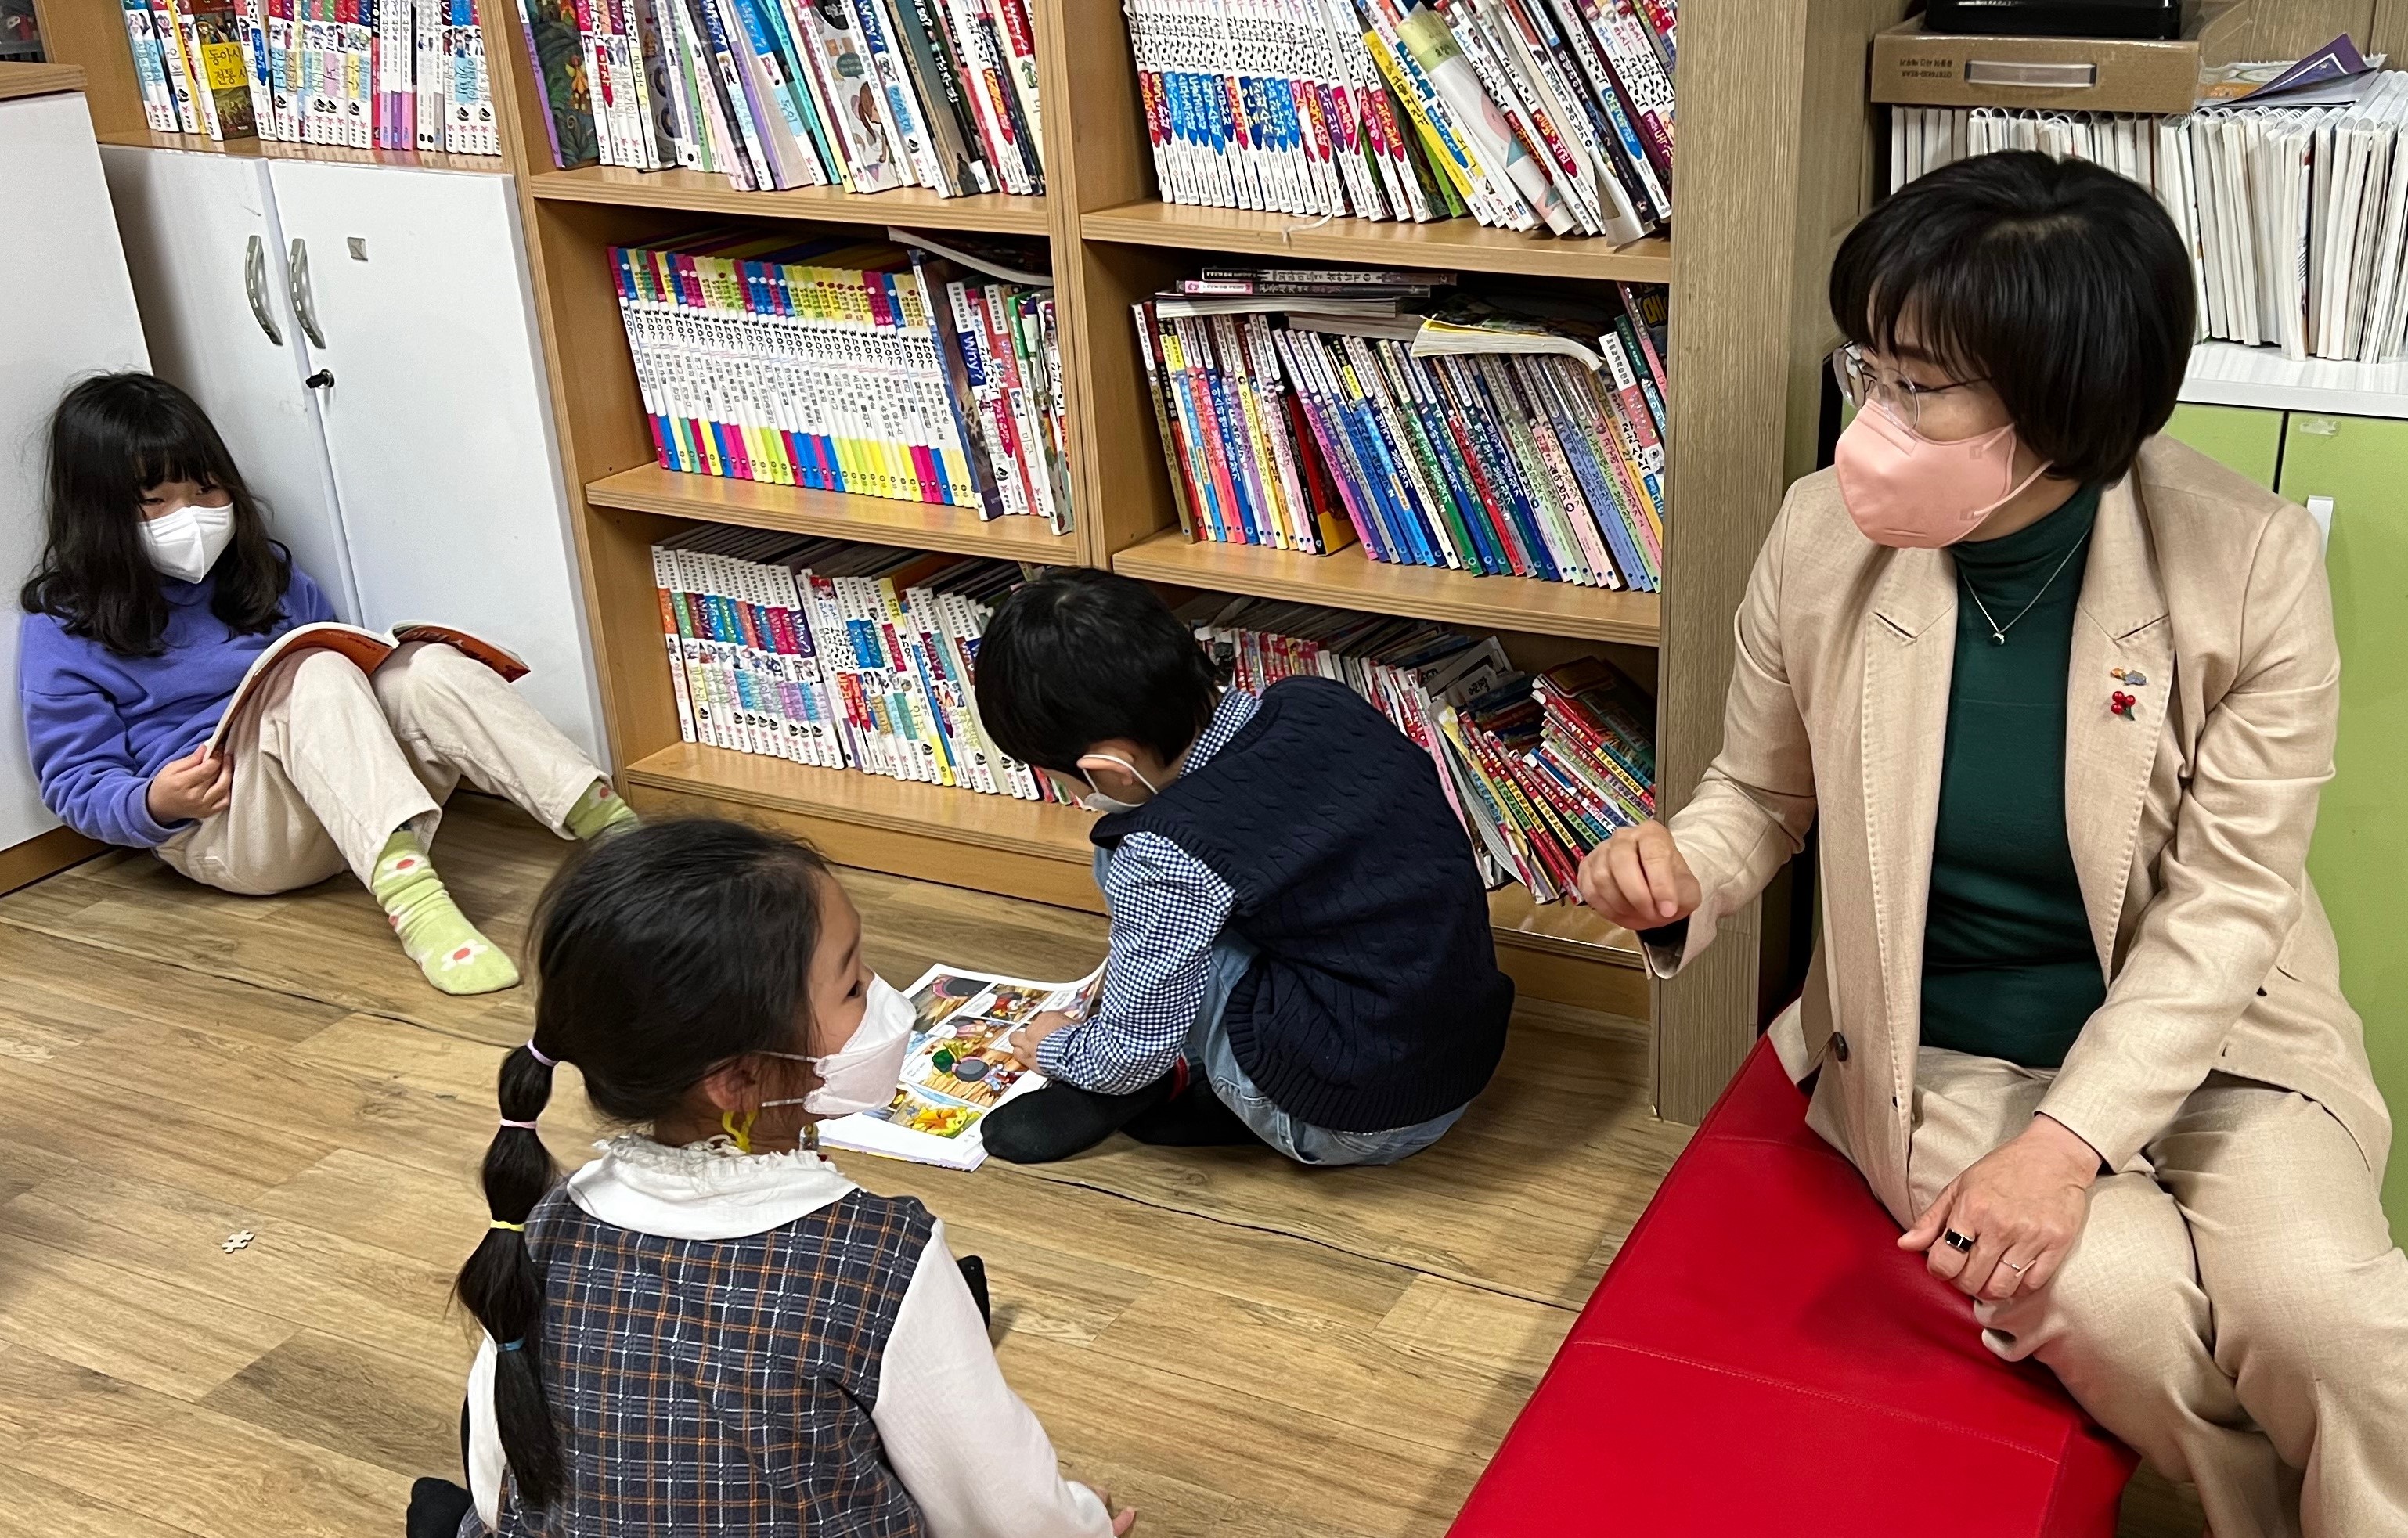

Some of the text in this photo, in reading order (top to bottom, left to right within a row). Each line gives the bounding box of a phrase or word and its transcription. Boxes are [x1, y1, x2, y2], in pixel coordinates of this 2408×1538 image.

[1137, 13, 1159, 66] 과학상식
[1152, 13, 1173, 67] 과학상식
[1163, 13, 1185, 67] 과학상식
[1175, 13, 1198, 67] 과학상식
[1187, 14, 1209, 69] 과학상식
[1199, 14, 1222, 70] 과학상식
[1224, 16, 1248, 70] 과학상식
[1236, 17, 1260, 72] 과학상식
[1249, 17, 1273, 72] 과학상식
[1262, 18, 1286, 74] 과학상식
[1274, 20, 1299, 75] 과학상식
[1297, 24, 1324, 79] 과학상식
[1312, 27, 1339, 81] 과학상식
[1571, 31, 1610, 83] 과학상식
[214, 69, 235, 85] 전통
[1610, 55, 1649, 106] 과학상식
[1630, 54, 1664, 106] 과학상식
[1213, 76, 1232, 125] 응급처치
[1240, 85, 1261, 127] 인체
[1251, 80, 1274, 133] 과학수사
[1318, 88, 1341, 134] 전기 자석
[1565, 103, 1588, 141] 살아남기
[963, 336, 986, 383] Why?
[1224, 442, 1241, 481] 보물찾기
[1253, 448, 1269, 485] 보물찾기
[1321, 443, 1344, 481] 보물찾기
[1388, 449, 1414, 488] 보물찾기
[1427, 464, 1452, 502] 보물찾기
[1437, 452, 1462, 492] 보물찾기
[1498, 458, 1524, 496] 보물찾기
[1523, 463, 1548, 502] 보물찾기
[1546, 463, 1570, 499] 살아남기
[1408, 466, 1431, 504] 보물찾기
[1491, 465, 1516, 504] 보물찾기
[1537, 470, 1562, 507] 보물찾기
[1560, 467, 1584, 506] 보물찾기
[1577, 468, 1602, 506] 보물찾기
[1591, 471, 1616, 510] 보물찾기
[1618, 477, 1642, 517] 보물찾기
[1611, 491, 1637, 529] 보물찾기
